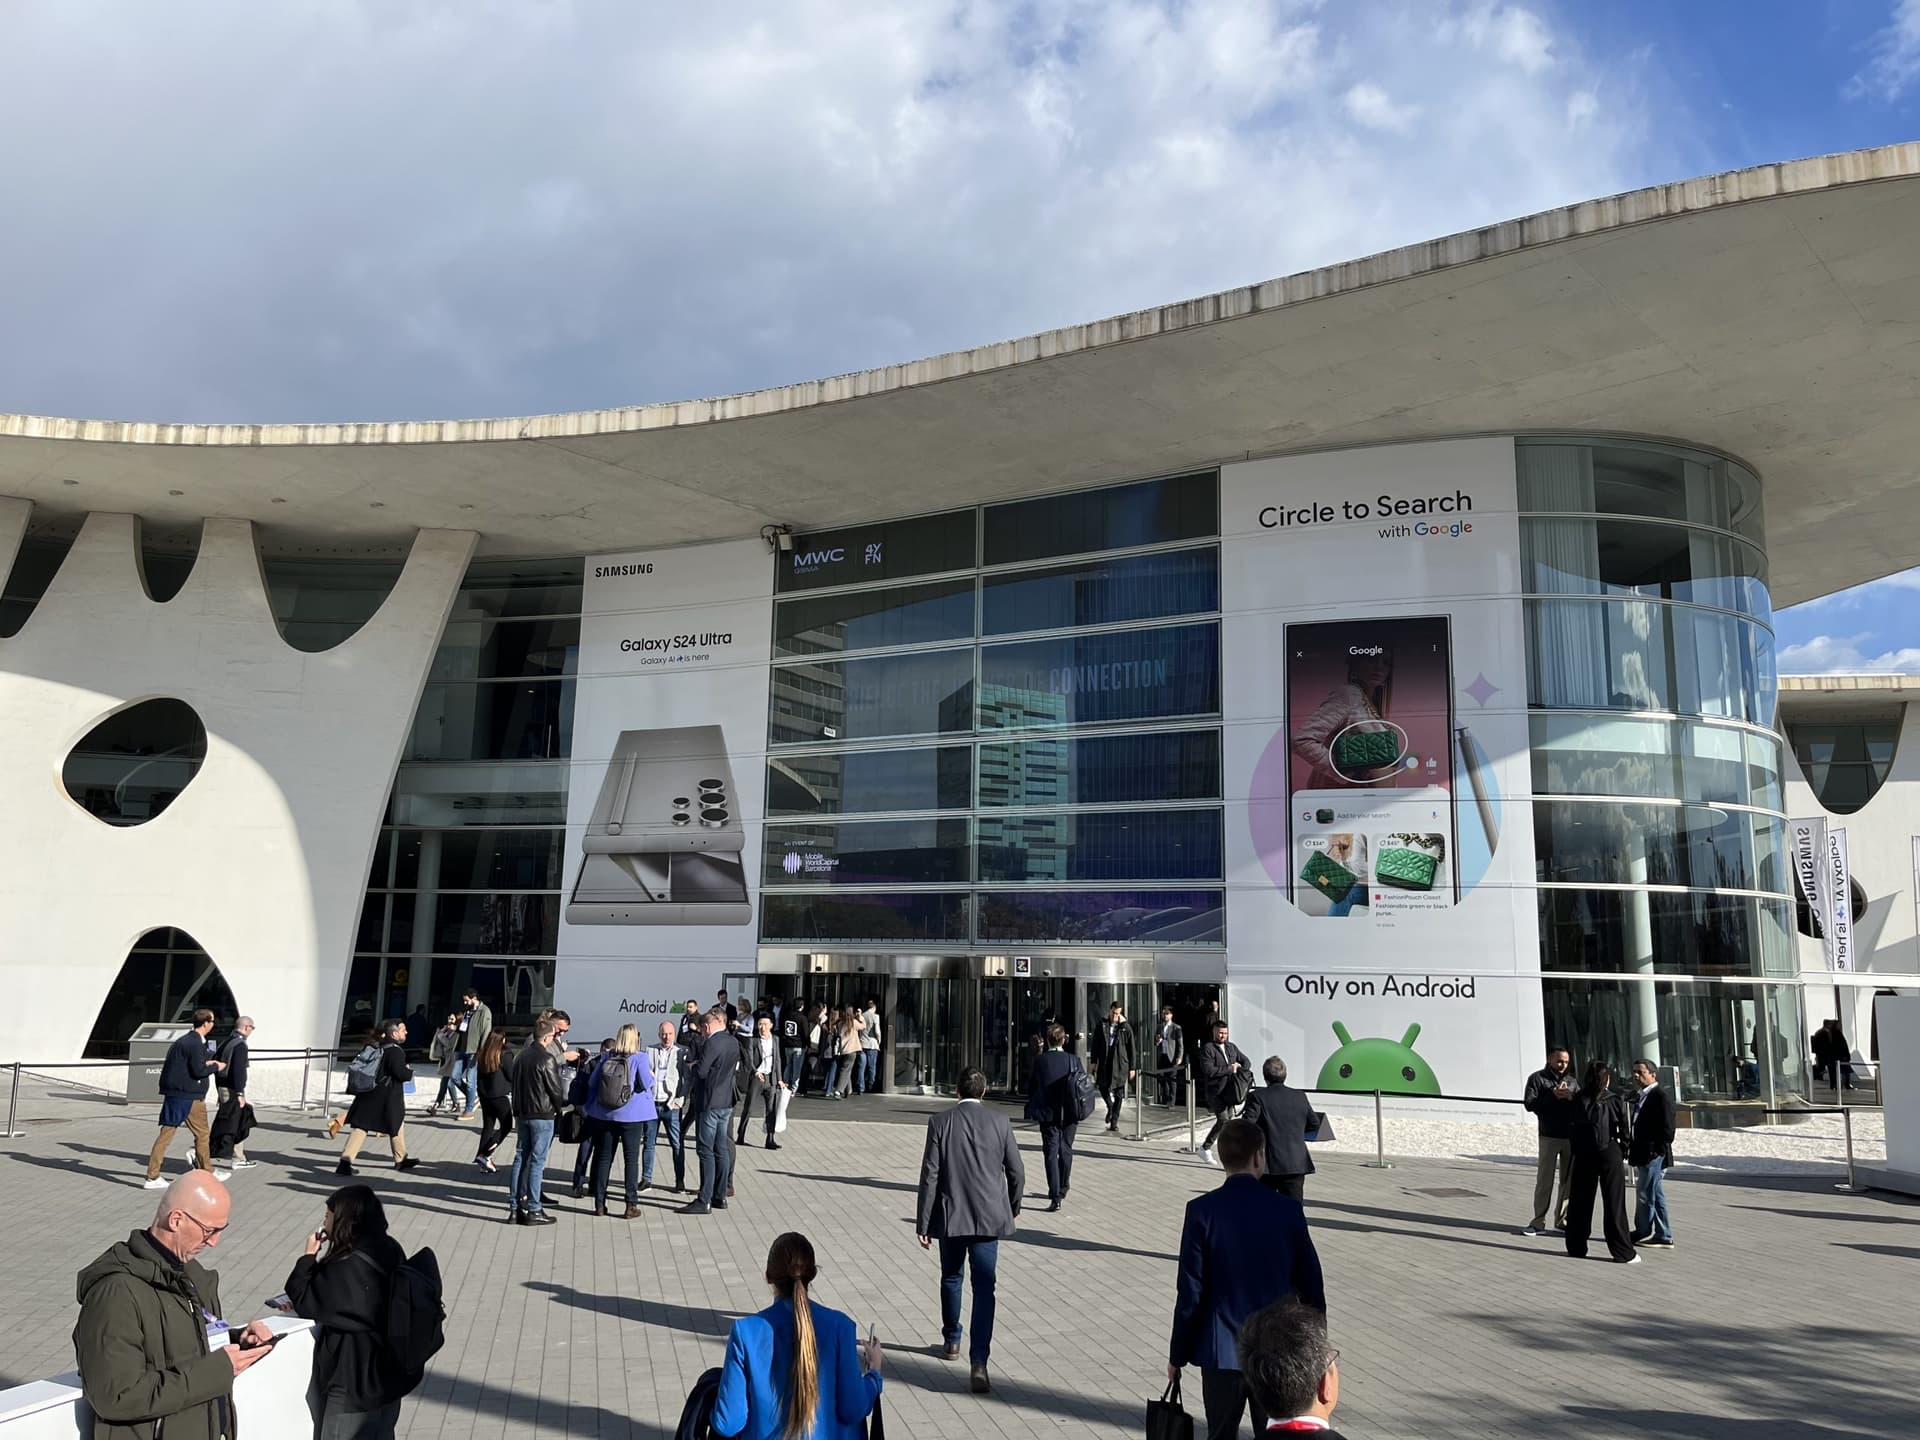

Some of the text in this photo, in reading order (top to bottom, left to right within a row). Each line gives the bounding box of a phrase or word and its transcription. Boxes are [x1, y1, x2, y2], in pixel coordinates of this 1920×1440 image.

[1258, 490, 1473, 529] Circle to Search
[1378, 520, 1473, 539] with Google
[794, 548, 845, 567] MWC
[864, 553, 881, 565] FN
[595, 563, 654, 578] SAMSUNG
[620, 632, 732, 653] Galaxy S24 Ultra
[1349, 645, 1383, 657] Google
[641, 653, 710, 666] Galaxy AI is here
[1049, 658, 1168, 694] CONNECTION
[1285, 974, 1476, 1000] Only on Android
[618, 998, 667, 1014] Android
